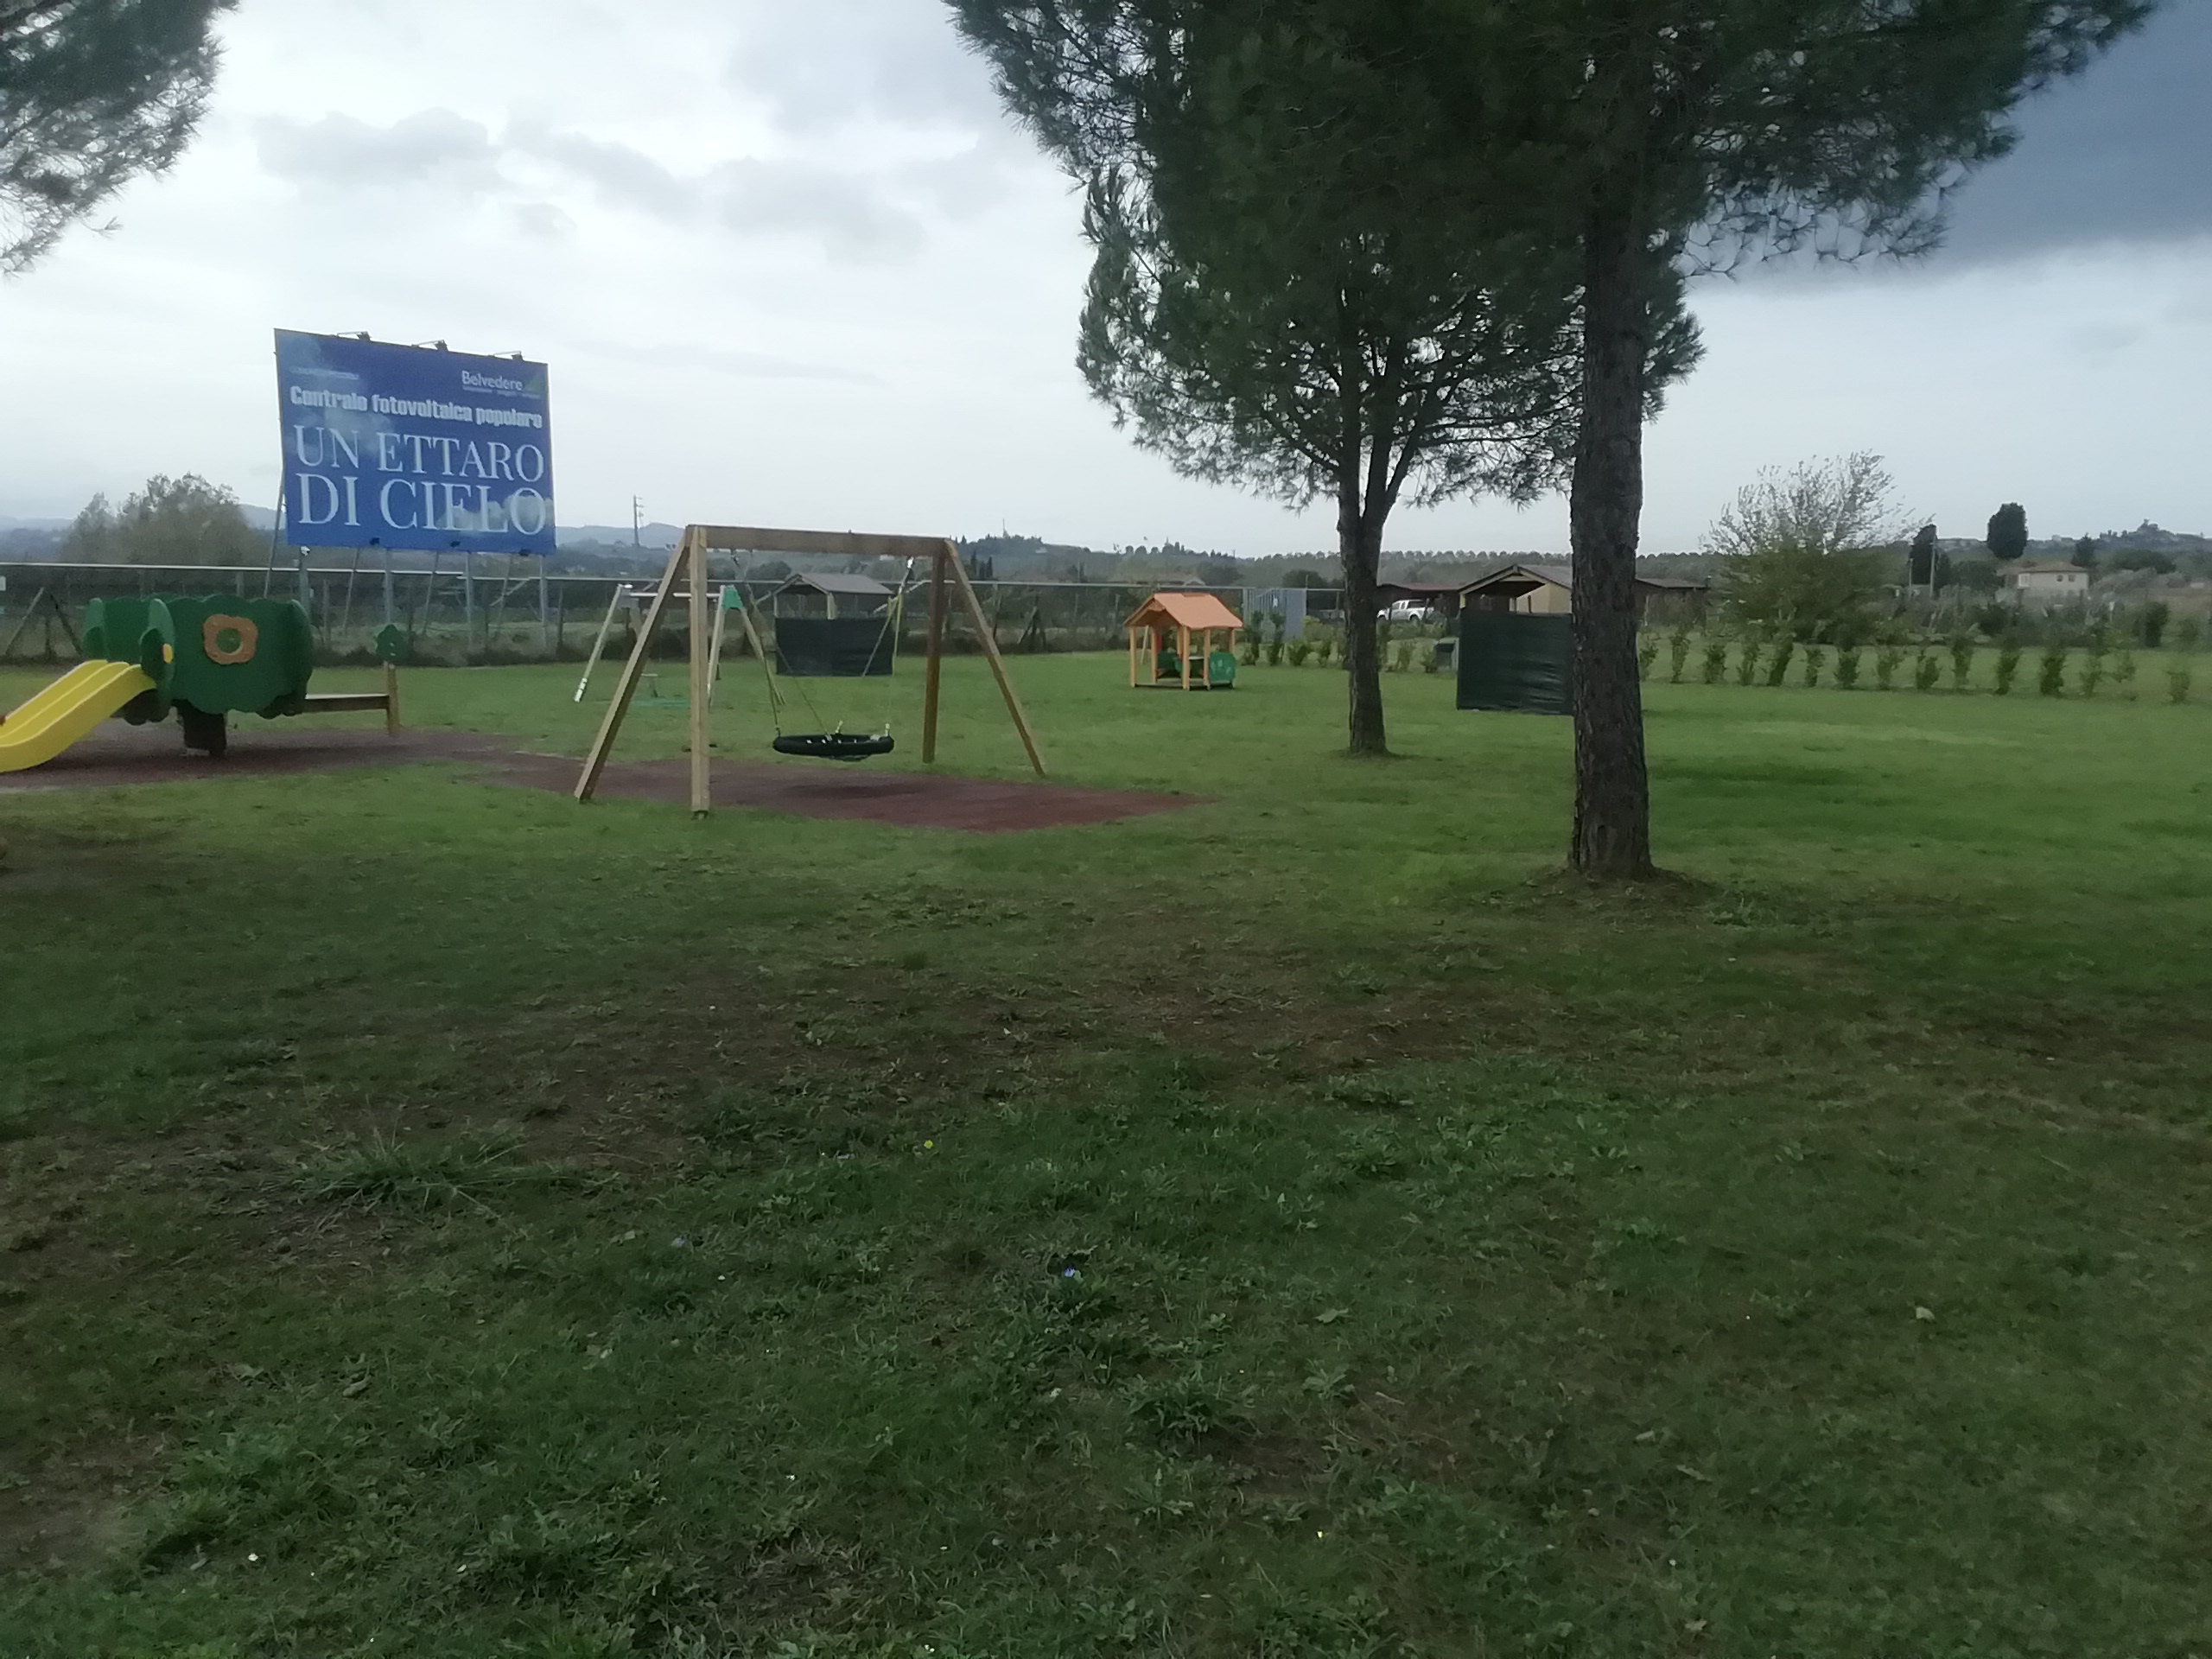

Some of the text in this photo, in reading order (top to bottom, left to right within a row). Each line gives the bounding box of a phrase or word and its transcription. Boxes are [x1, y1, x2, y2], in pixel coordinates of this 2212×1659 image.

[461, 370, 523, 391] Belvedere
[372, 394, 474, 422] fotovoltaica
[475, 408, 543, 429] popolare
[294, 424, 544, 482] UN ETTARO
[295, 473, 546, 535] DI CIELO
